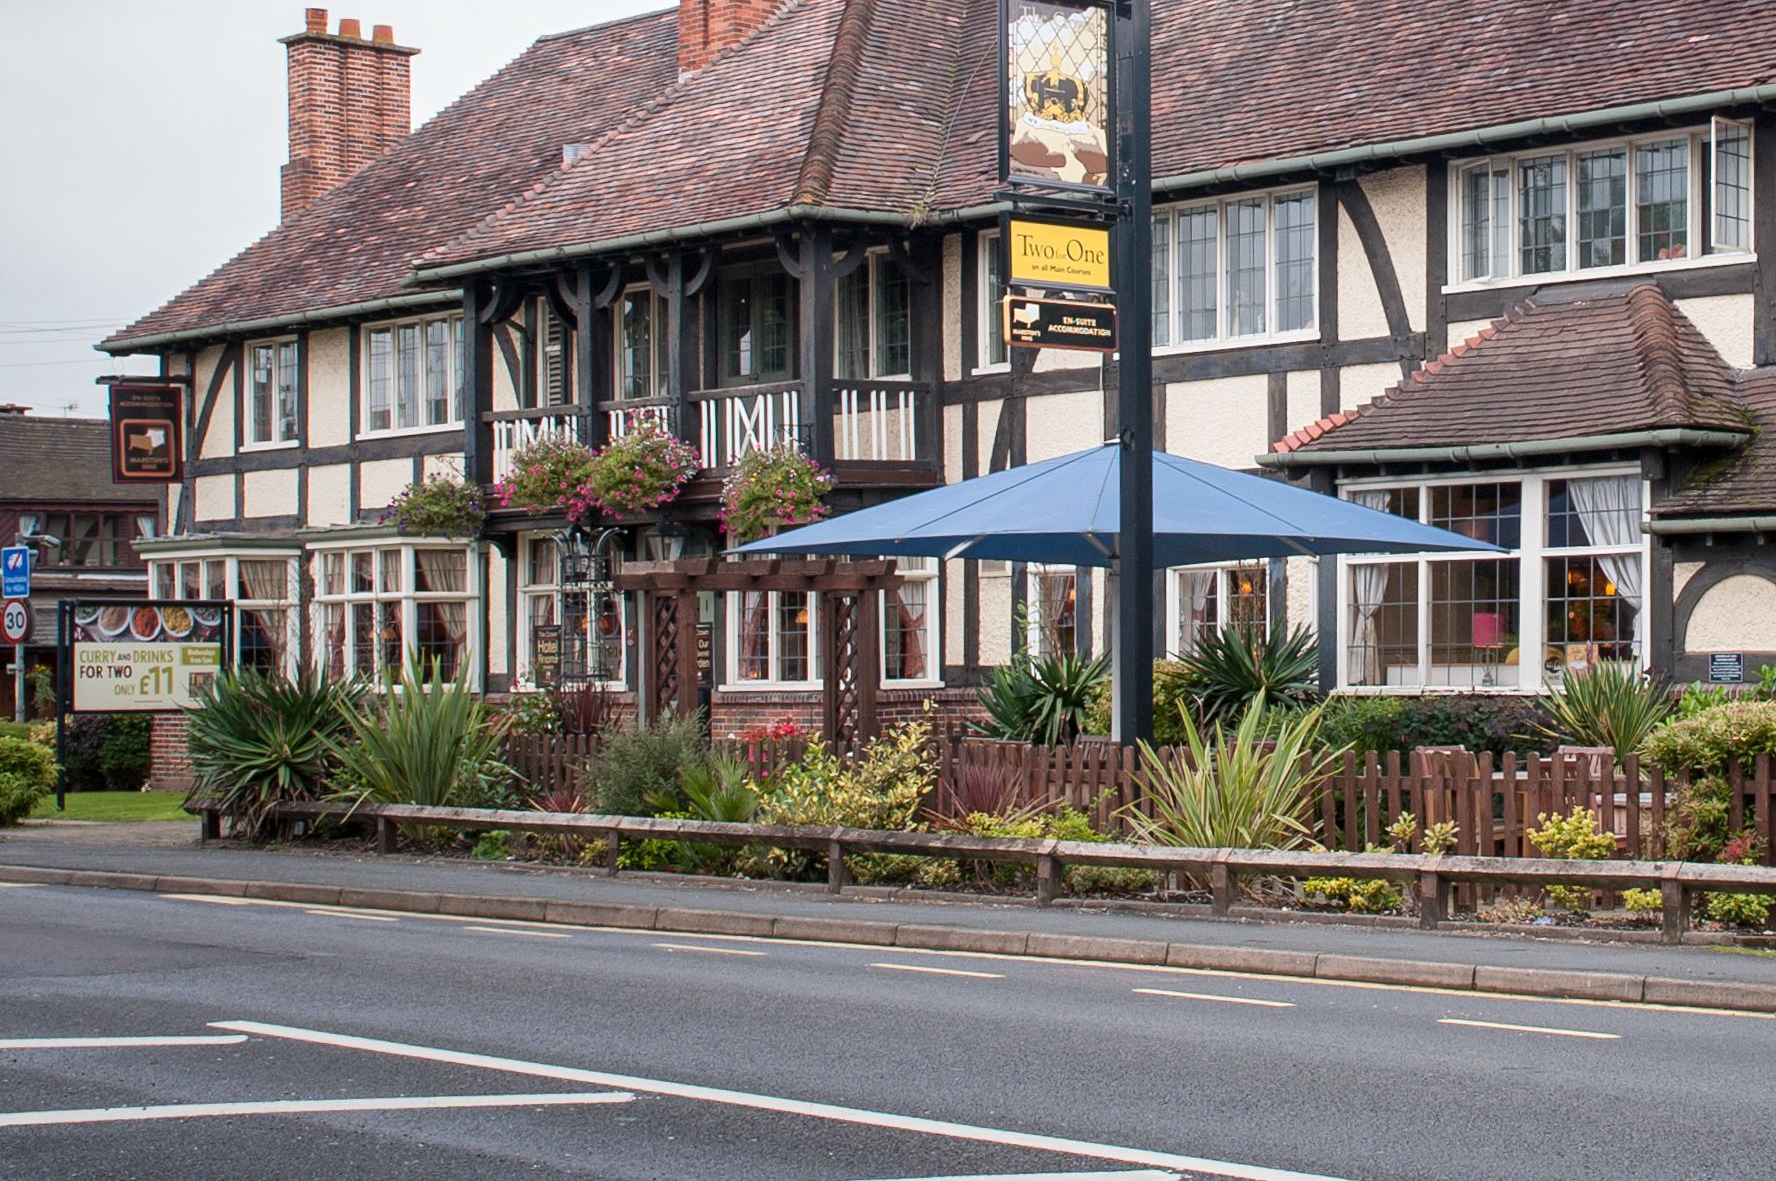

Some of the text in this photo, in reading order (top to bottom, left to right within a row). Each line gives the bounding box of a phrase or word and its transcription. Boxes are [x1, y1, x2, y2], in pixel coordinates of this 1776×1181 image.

[1017, 233, 1055, 259] Two
[1066, 239, 1105, 265] One
[1049, 265, 1065, 273] Main
[1066, 267, 1091, 275] Courses
[1063, 316, 1096, 326] EN-SUITE
[1048, 324, 1112, 337] ACCOMMODATION
[6, 611, 25, 630] 30
[537, 640, 558, 653] Hotel
[79, 650, 117, 664] CURRY
[133, 650, 174, 663] DRINKS
[79, 665, 133, 678] FOR TWO
[114, 666, 174, 695] ONLY £11
